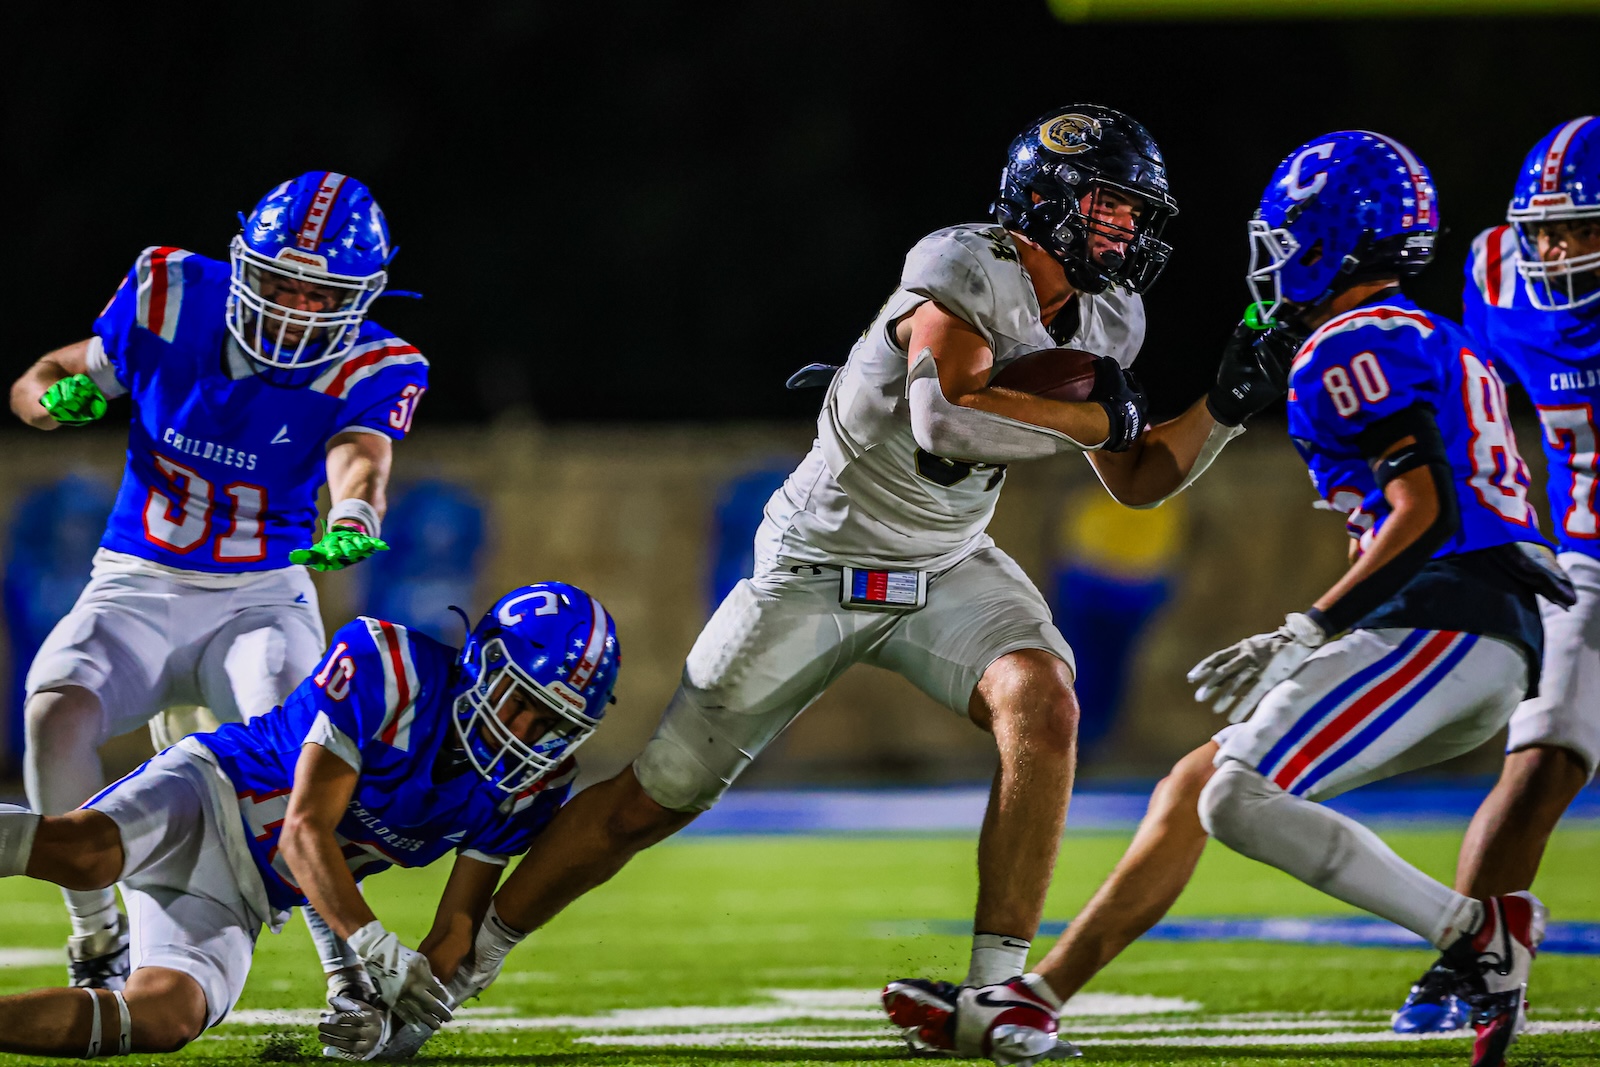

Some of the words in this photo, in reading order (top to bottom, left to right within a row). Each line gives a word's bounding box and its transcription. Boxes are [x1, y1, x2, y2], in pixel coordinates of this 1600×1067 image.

[1286, 142, 1336, 201] C
[1322, 349, 1391, 419] 80
[163, 426, 259, 472] CHILDRESS
[141, 450, 269, 563] 31
[498, 590, 559, 627] C
[348, 799, 425, 852] CHILDRESS
